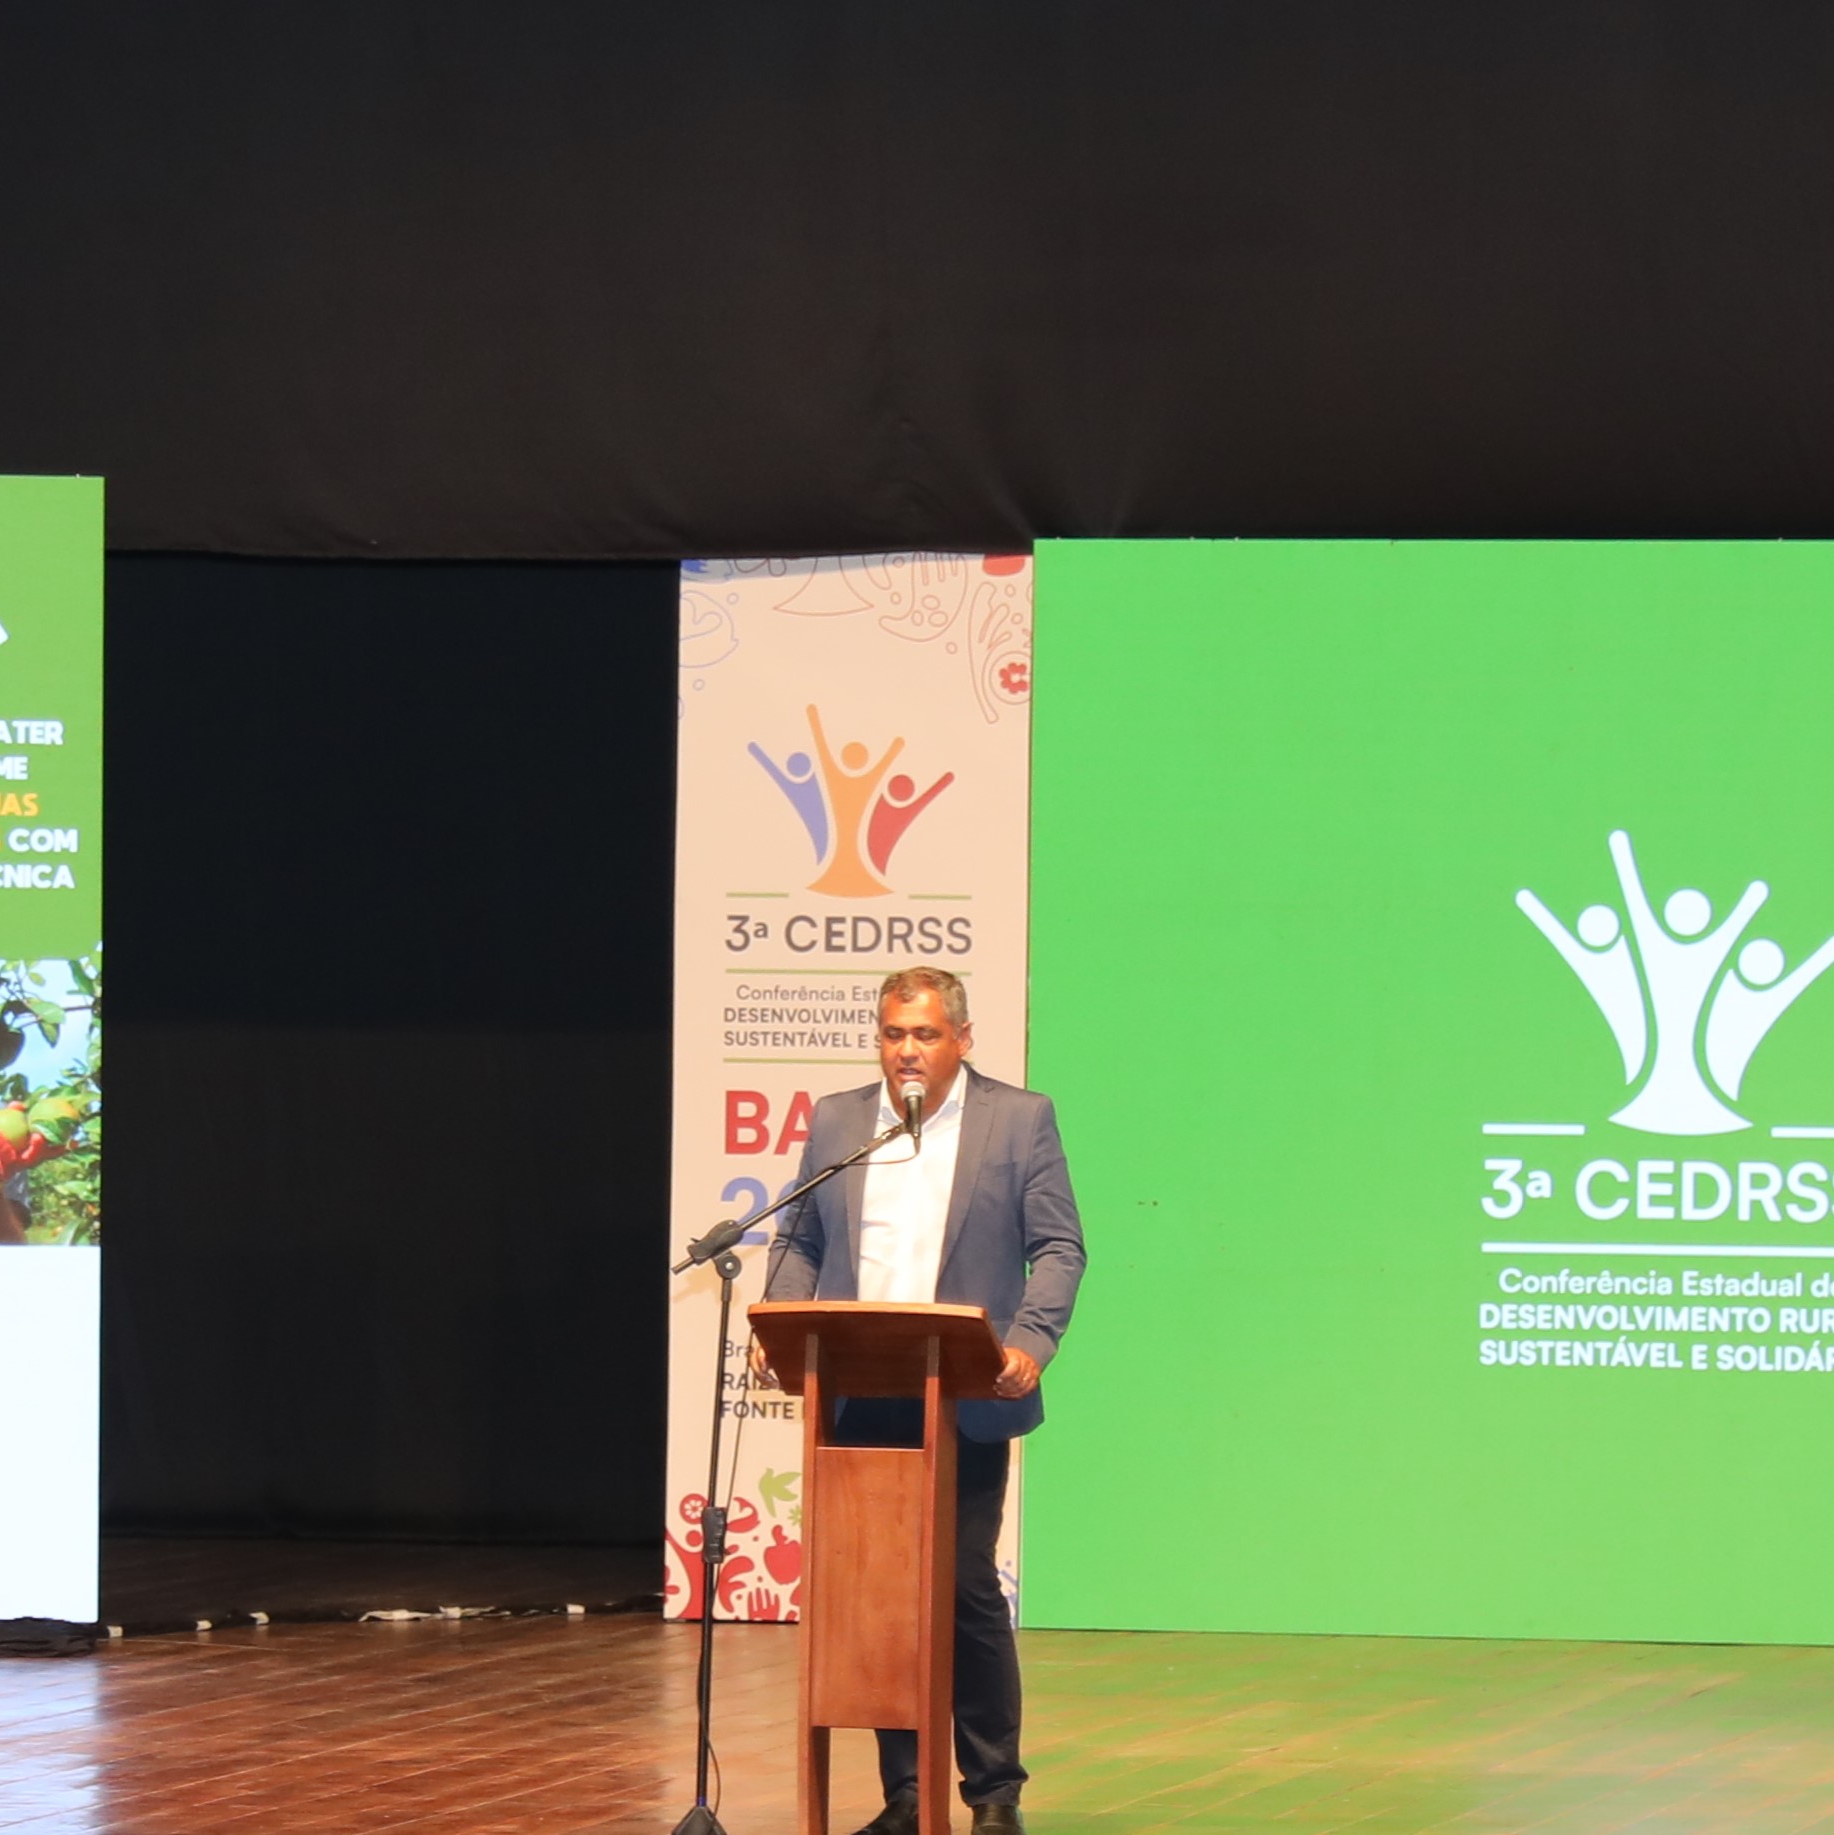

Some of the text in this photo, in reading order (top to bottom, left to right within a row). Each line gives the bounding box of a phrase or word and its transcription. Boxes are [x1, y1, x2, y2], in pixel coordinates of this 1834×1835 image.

[8, 828, 78, 853] COM
[725, 914, 973, 955] 3ª CEDRSS
[736, 984, 846, 1001] Conferência
[724, 1008, 879, 1025] DESENVOLVIMEN
[724, 1027, 852, 1048] SUSTENTÁVEL
[858, 1034, 868, 1049] E
[1481, 1158, 1552, 1219] 3ª
[1498, 1267, 1673, 1296] Conferência
[1682, 1270, 1803, 1298] Estadual
[1479, 1303, 1772, 1333] DESENVOLVIMENTO
[1479, 1336, 1684, 1368] SUSTENTÁVEL
[1691, 1344, 1709, 1370] E
